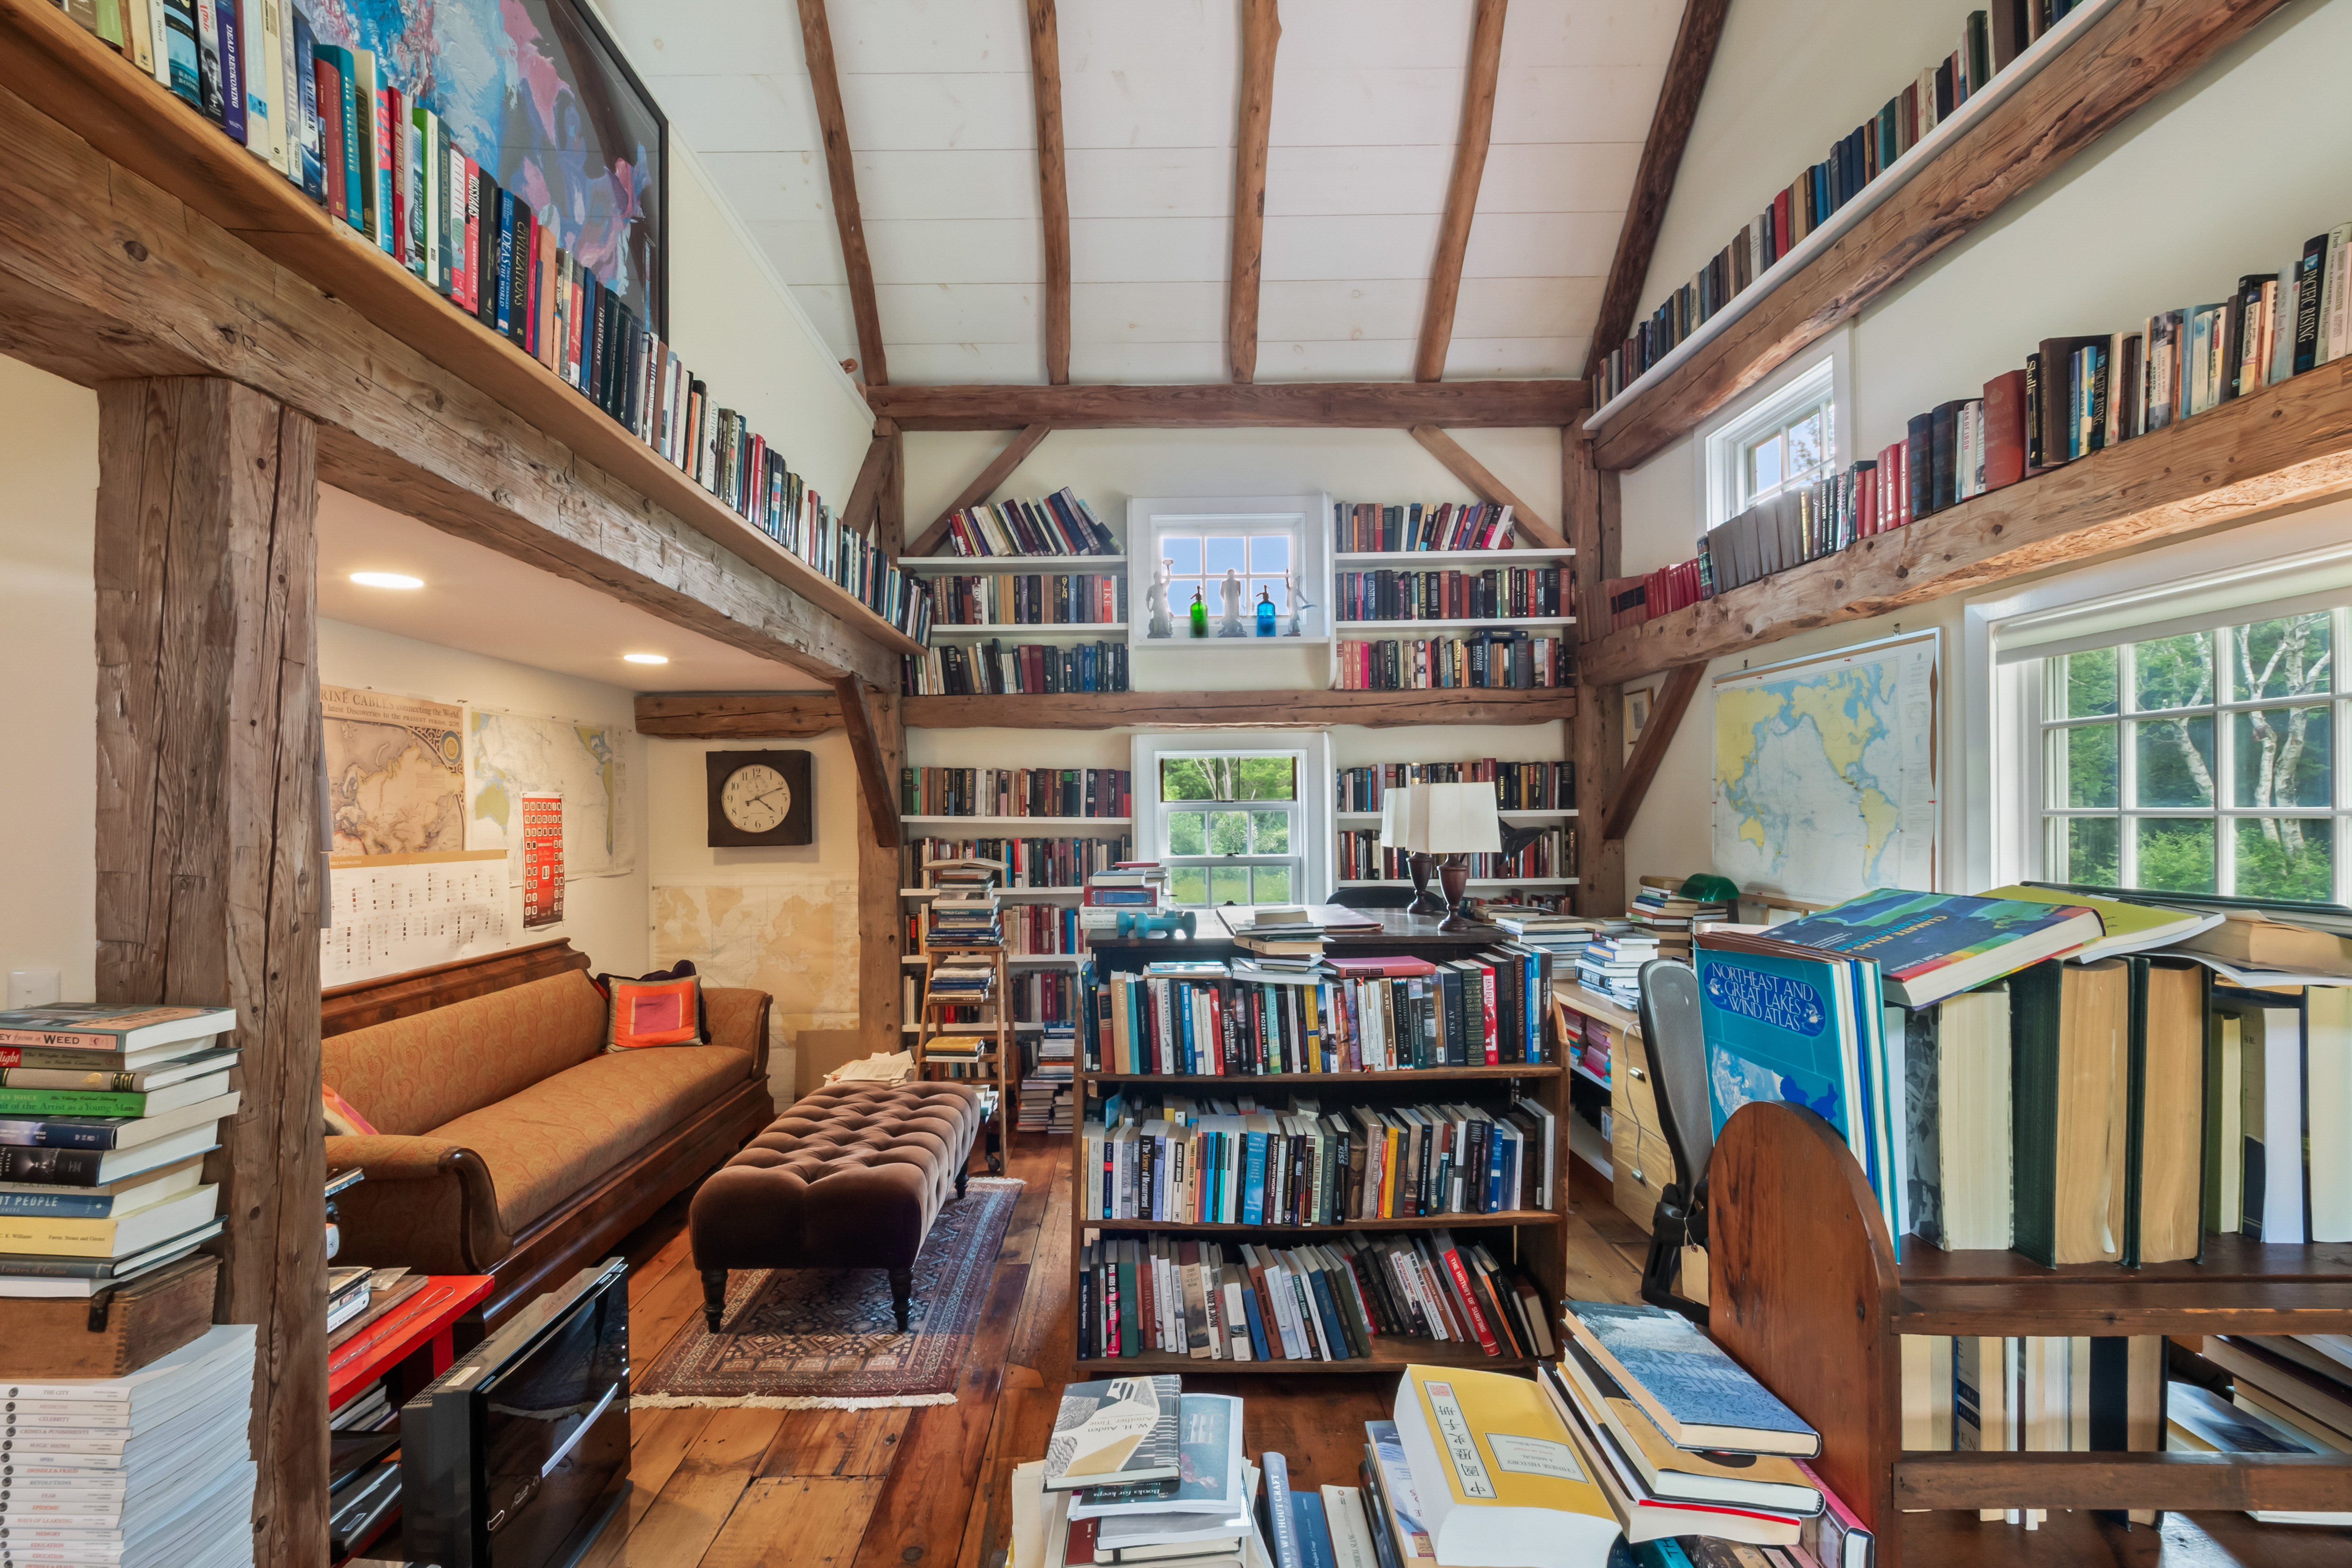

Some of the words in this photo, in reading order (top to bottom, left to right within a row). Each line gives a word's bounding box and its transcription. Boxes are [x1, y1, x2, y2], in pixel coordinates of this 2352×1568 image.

[226, 24, 235, 53] DEAD
[228, 53, 239, 109] RECKONING
[306, 71, 316, 132] LEVIATHAN
[468, 173, 480, 220] RUSSIANS
[501, 229, 512, 265] IDEAS
[514, 221, 526, 306] CIVILIZATIONS
[2301, 269, 2318, 309] PACIFIC
[596, 306, 605, 366] IMPROVEMENT
[2298, 307, 2316, 343] RISING
[2026, 360, 2036, 395] Skulls
[2095, 366, 2106, 398] PACIFIC
[710, 400, 718, 438] EMPIRE
[2092, 397, 2105, 426] RISING
[1965, 421, 1970, 430] OF
[1103, 588, 1112, 607] IKE
[328, 704, 343, 713] latest
[347, 707, 381, 718] Discoveries
[403, 715, 426, 723] PRESENT
[353, 693, 394, 710] CABLES
[397, 704, 431, 716] connecting
[433, 706, 441, 716] the
[742, 772, 748, 781] 11
[752, 768, 761, 777] 12
[731, 782, 739, 791] 10
[727, 795, 733, 803] 9
[731, 808, 737, 816] 8
[755, 819, 761, 829] 6
[1875, 913, 1932, 936] ATLANTIC
[1891, 915, 1948, 936] CLIMATE
[1834, 934, 1877, 952] OCEAN
[1853, 934, 1895, 951] ATLAS
[1889, 959, 1922, 972] Lindau
[1923, 953, 1944, 963] Ralf
[1711, 962, 1779, 993] NORTHEAST
[1784, 980, 1813, 1002] AND
[1725, 980, 1761, 1003] GREAT
[1764, 990, 1801, 1016] LAKES
[1728, 995, 1762, 1019] WIND
[1764, 1007, 1800, 1032] ATLAS
[44, 1034, 80, 1044] WEED
[1319, 1025, 1328, 1040] 1889
[11, 1102, 20, 1110] of
[23, 1102, 38, 1111] the
[40, 1102, 65, 1111] Artist
[85, 1103, 112, 1113] Young
[114, 1103, 135, 1112] Man
[1142, 1144, 1151, 1154] The
[15, 1196, 59, 1207] PEOPLE
[1141, 1177, 1151, 1208] Measurement
[1286, 1285, 1297, 1307] Islanders
[1293, 1275, 1304, 1299] EARTHQUAKE
[1299, 1298, 1309, 1319] STORMS
[1450, 1257, 1459, 1271] THE
[1455, 1271, 1471, 1296] HISTORY
[1467, 1297, 1475, 1305] OF
[1471, 1306, 1487, 1333] SURFING
[1648, 1350, 1709, 1367] SKY
[1622, 1360, 1756, 1384] RUNNING
[1673, 1377, 1742, 1396] THE
[1507, 1459, 1541, 1468] HISTORY
[1543, 1464, 1576, 1474] CHINESE
[1271, 1474, 1283, 1502] CRAFT
[1275, 1503, 1289, 1548] WITHOUT
